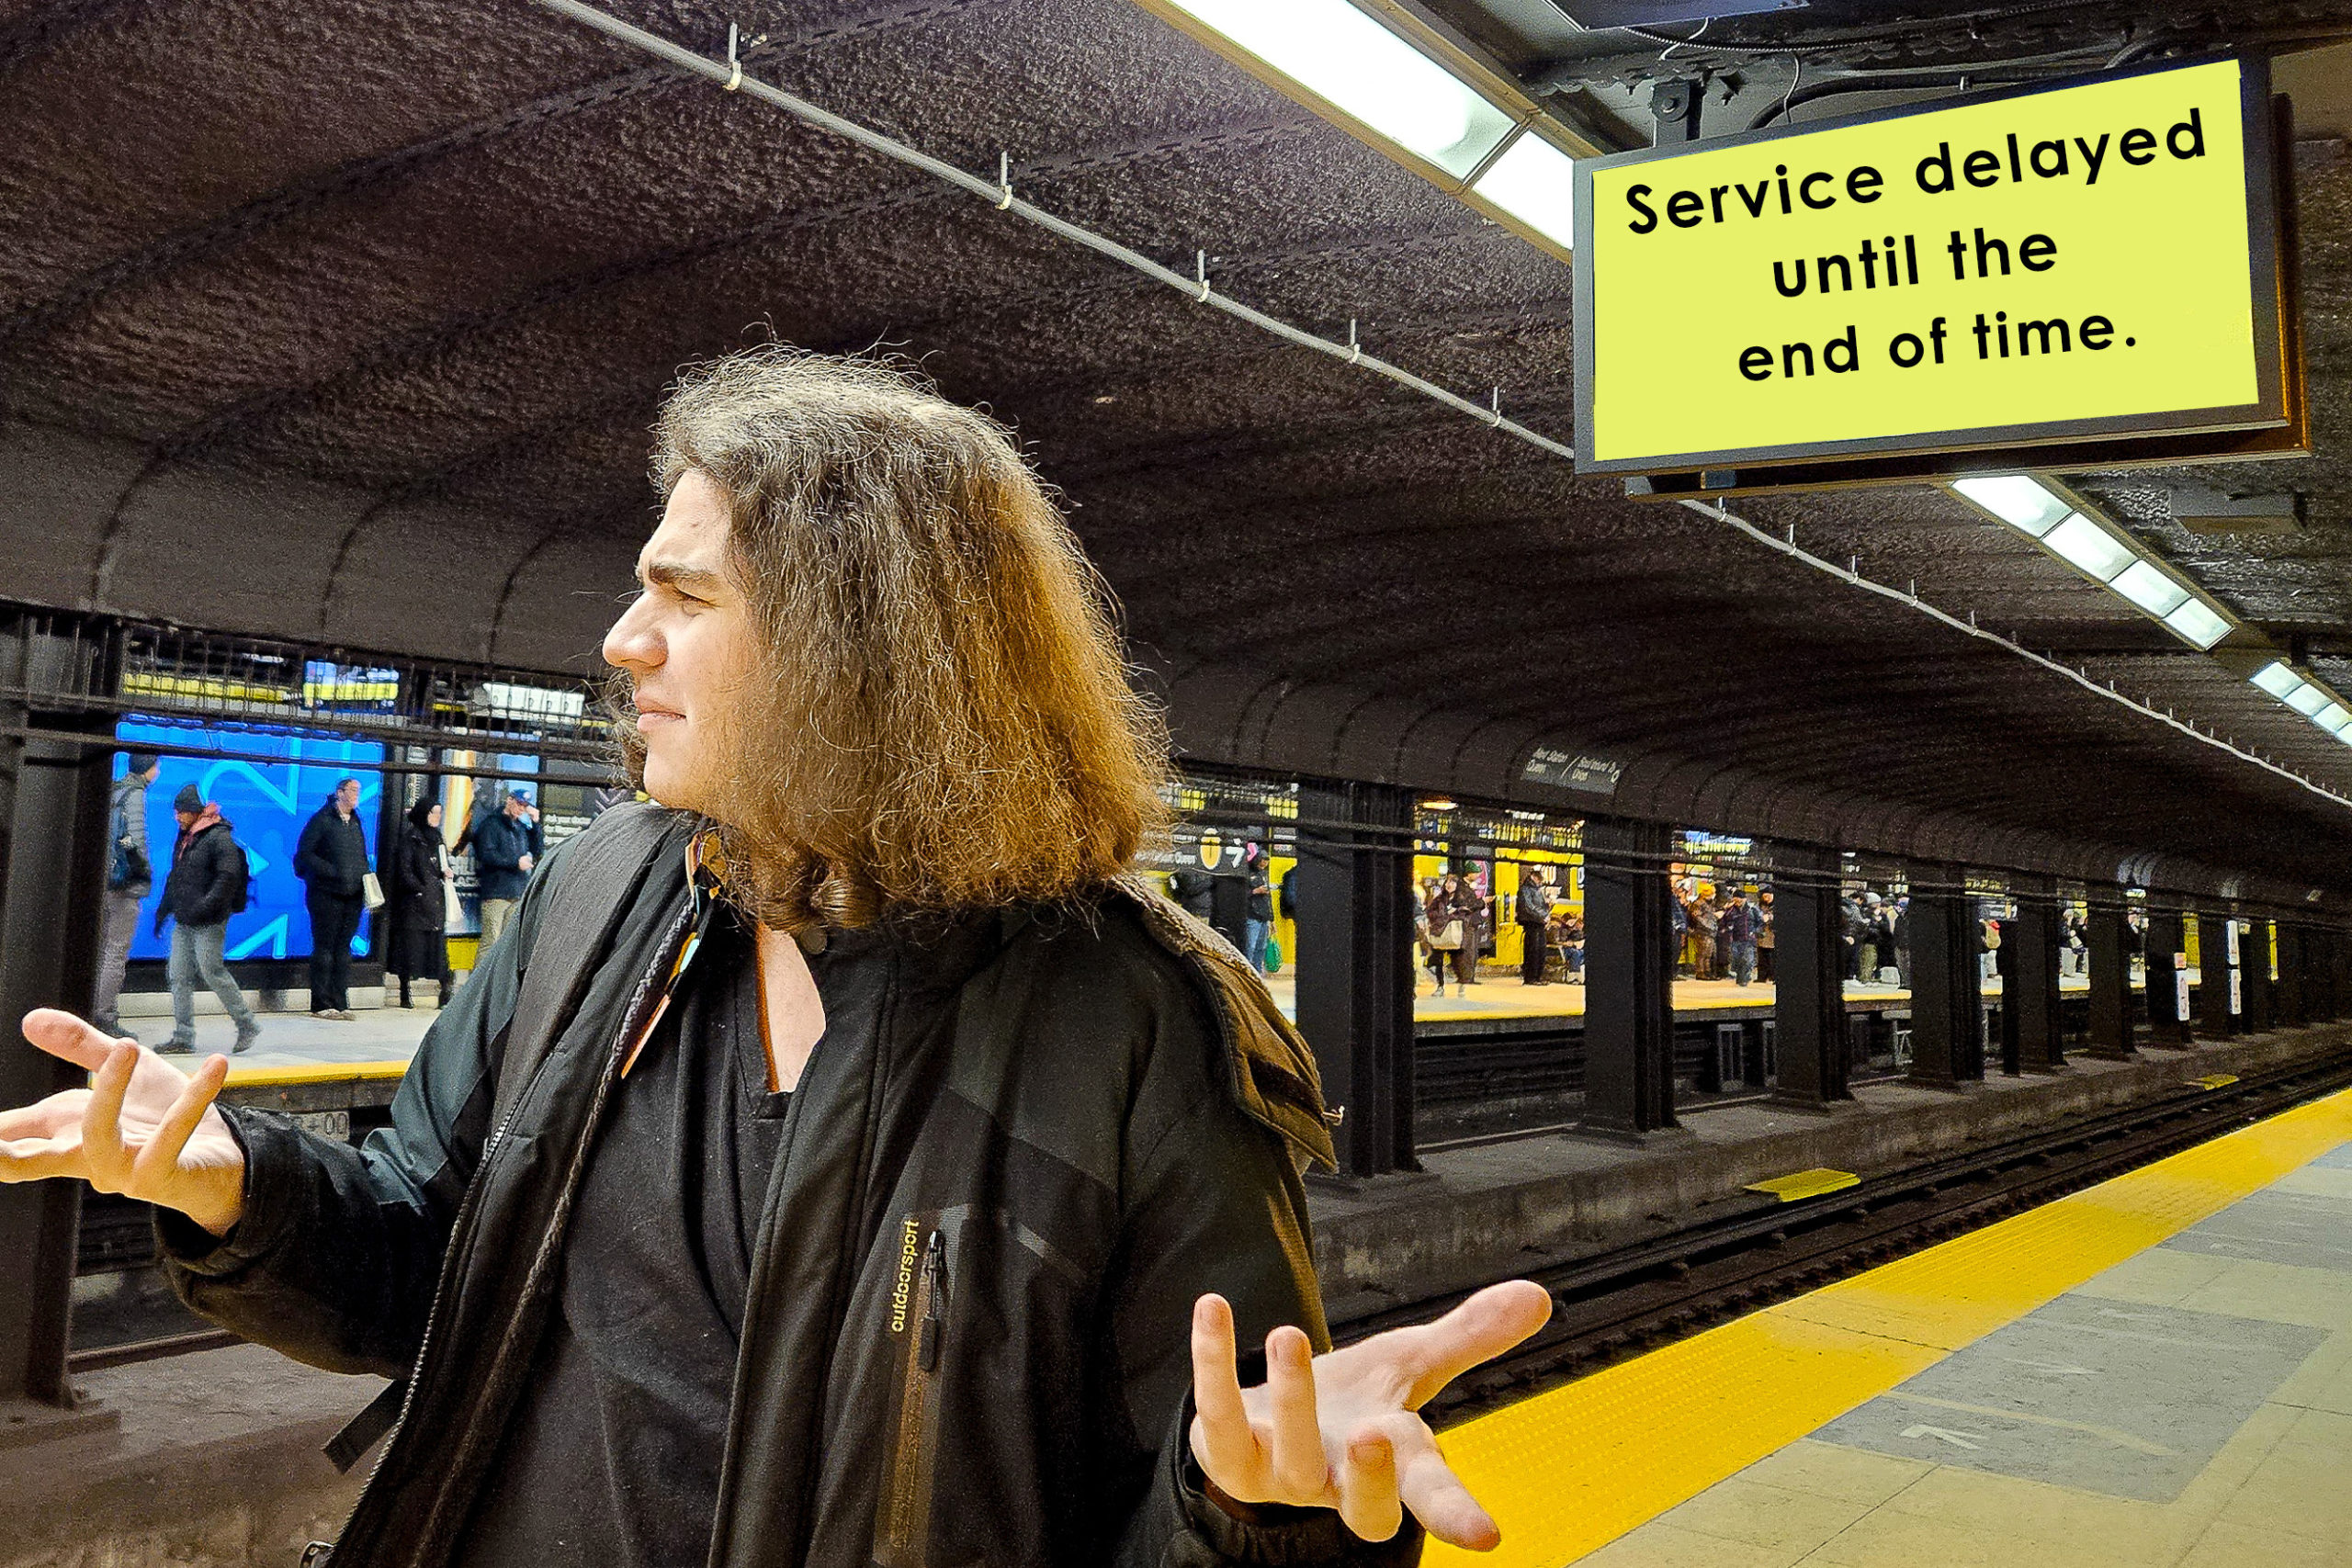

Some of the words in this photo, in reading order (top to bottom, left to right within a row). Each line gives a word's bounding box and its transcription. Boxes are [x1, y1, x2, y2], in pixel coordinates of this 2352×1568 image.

[1625, 164, 1884, 235] Service
[1915, 107, 2206, 195] delayed
[1772, 234, 1919, 298] until
[1947, 227, 2058, 281] the
[1738, 324, 1860, 382] end
[1888, 316, 1948, 368] of
[1972, 310, 2136, 360] time.
[891, 1219, 920, 1332] outdoorsport
